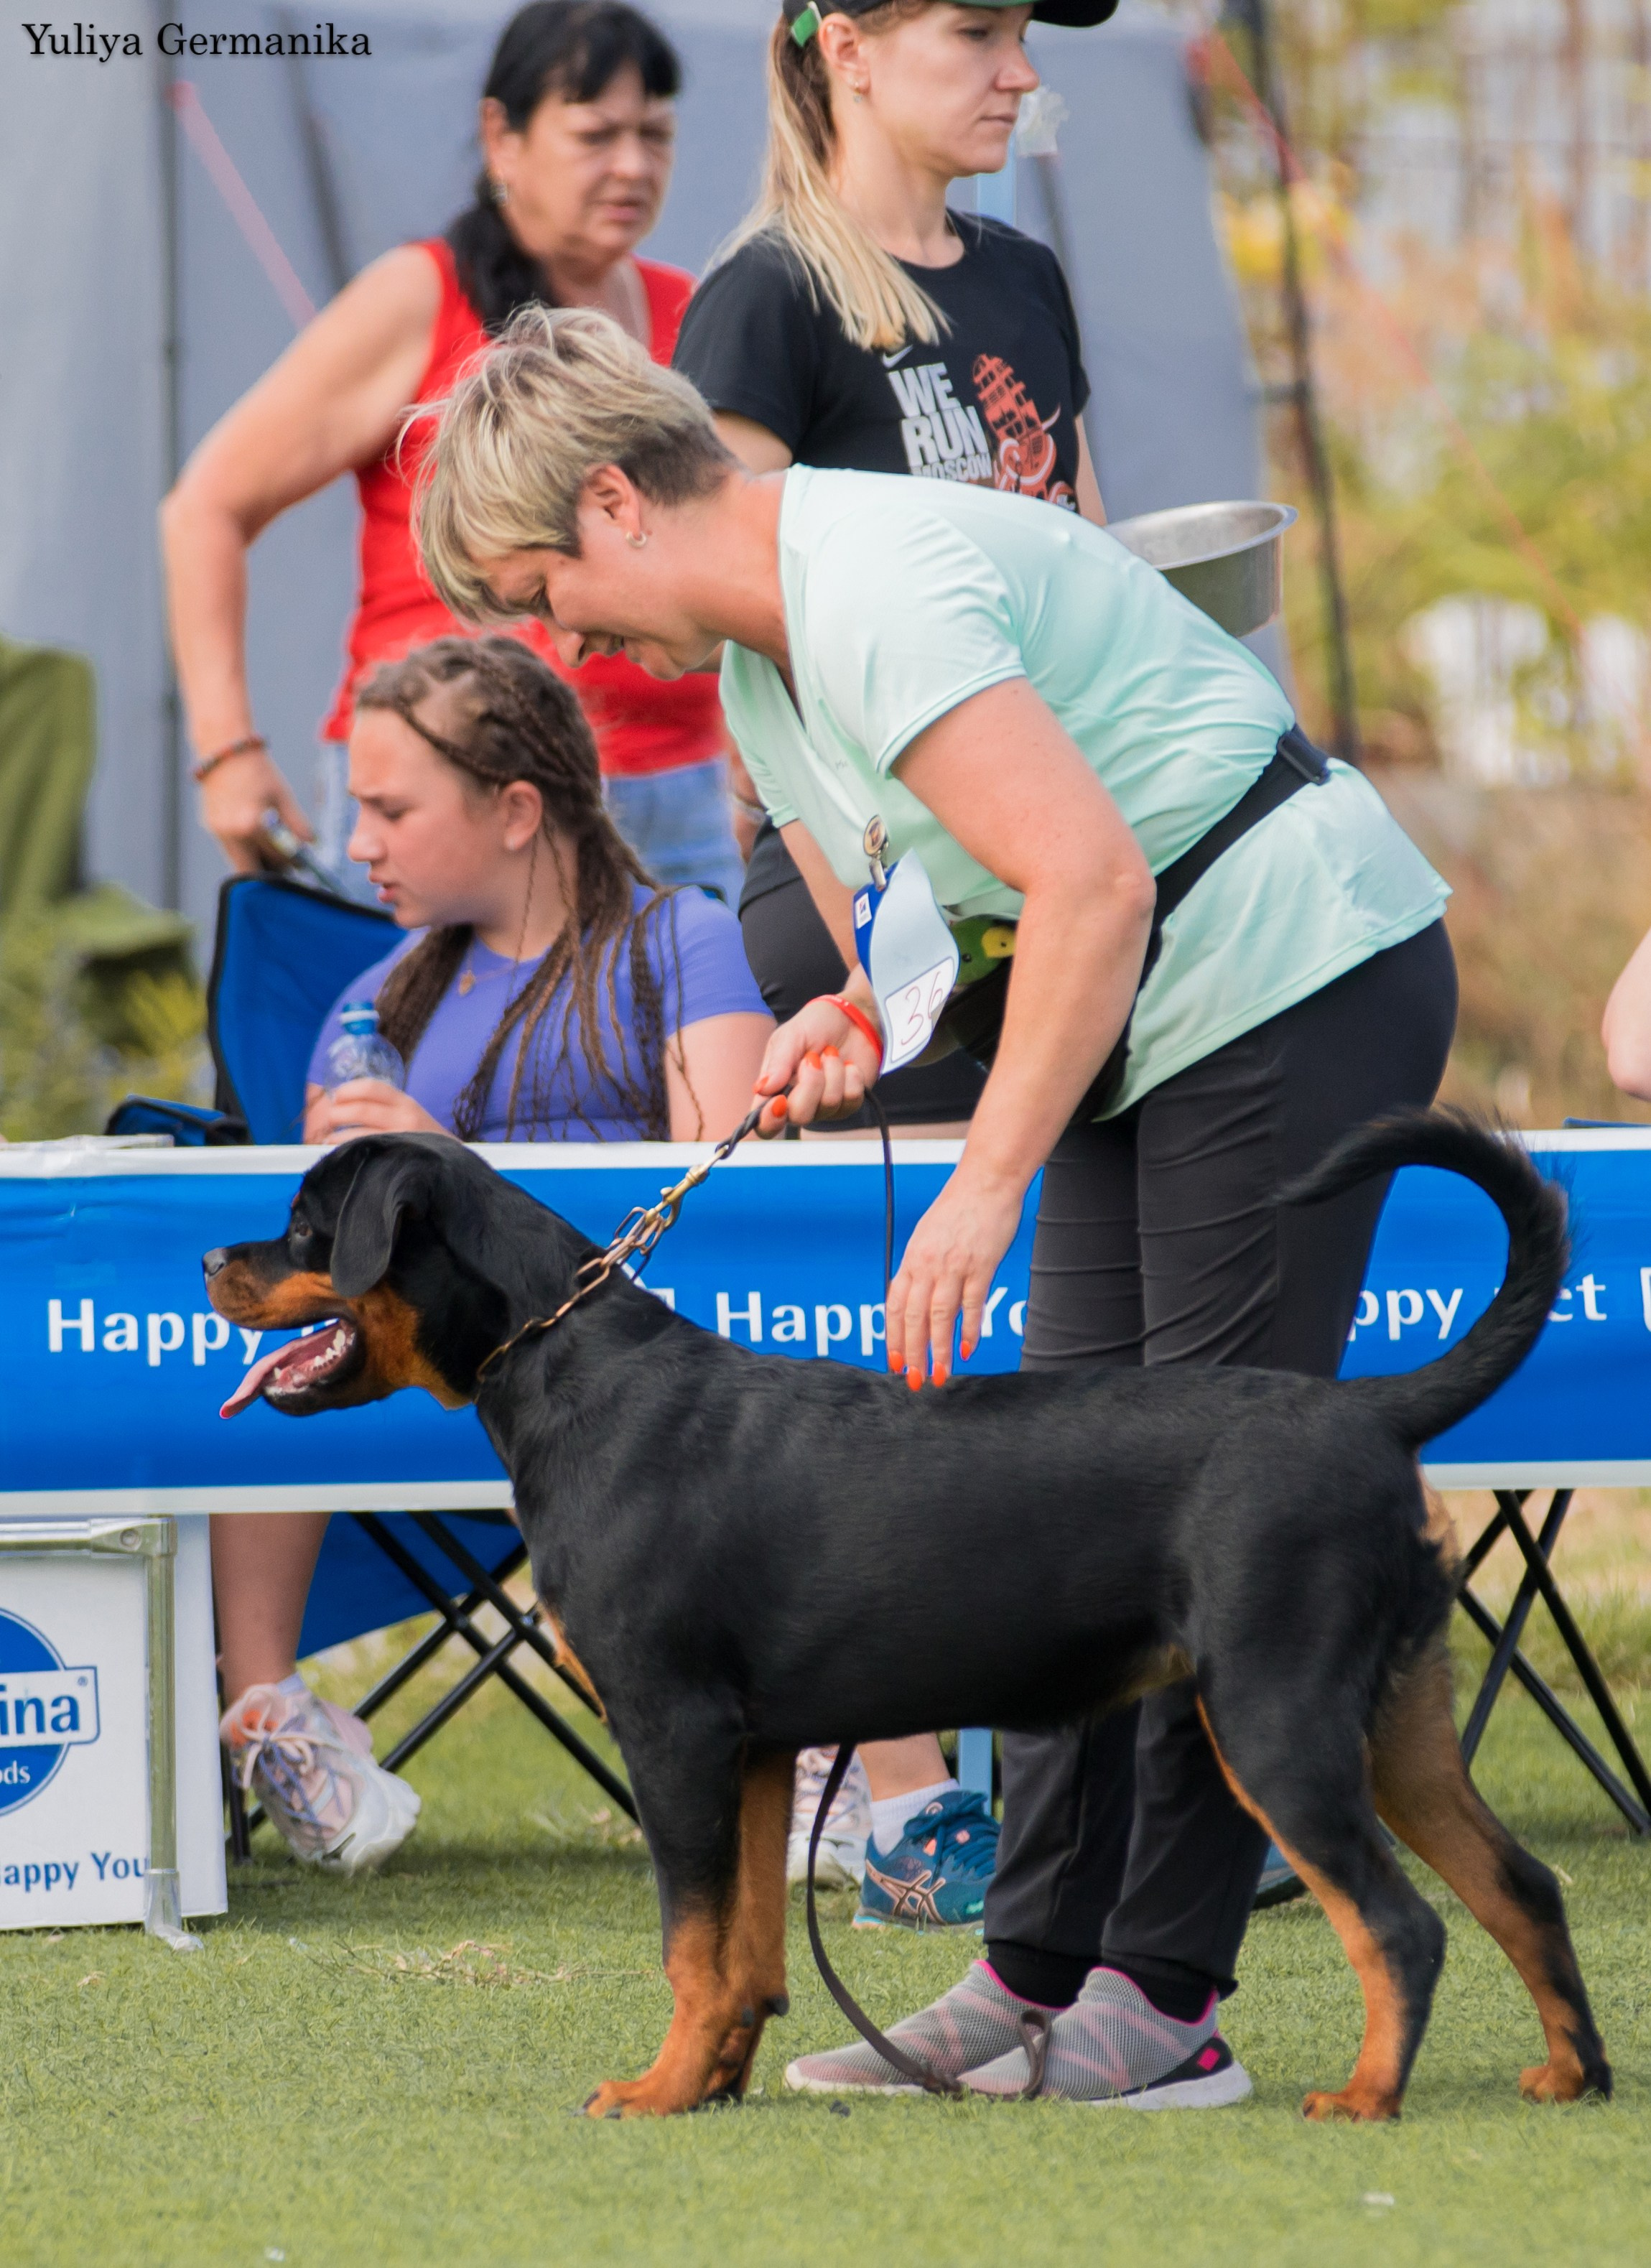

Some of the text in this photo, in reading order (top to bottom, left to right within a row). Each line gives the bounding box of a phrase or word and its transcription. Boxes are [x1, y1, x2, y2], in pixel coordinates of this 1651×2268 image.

[888, 363, 961, 419] WE
[901, 406, 989, 468] RUN
[901, 971, 944, 1046] 36
[717, 1292, 886, 1356] Happ
[1347, 1288, 1464, 1341] ppy
[0, 1862, 79, 1892] appy
